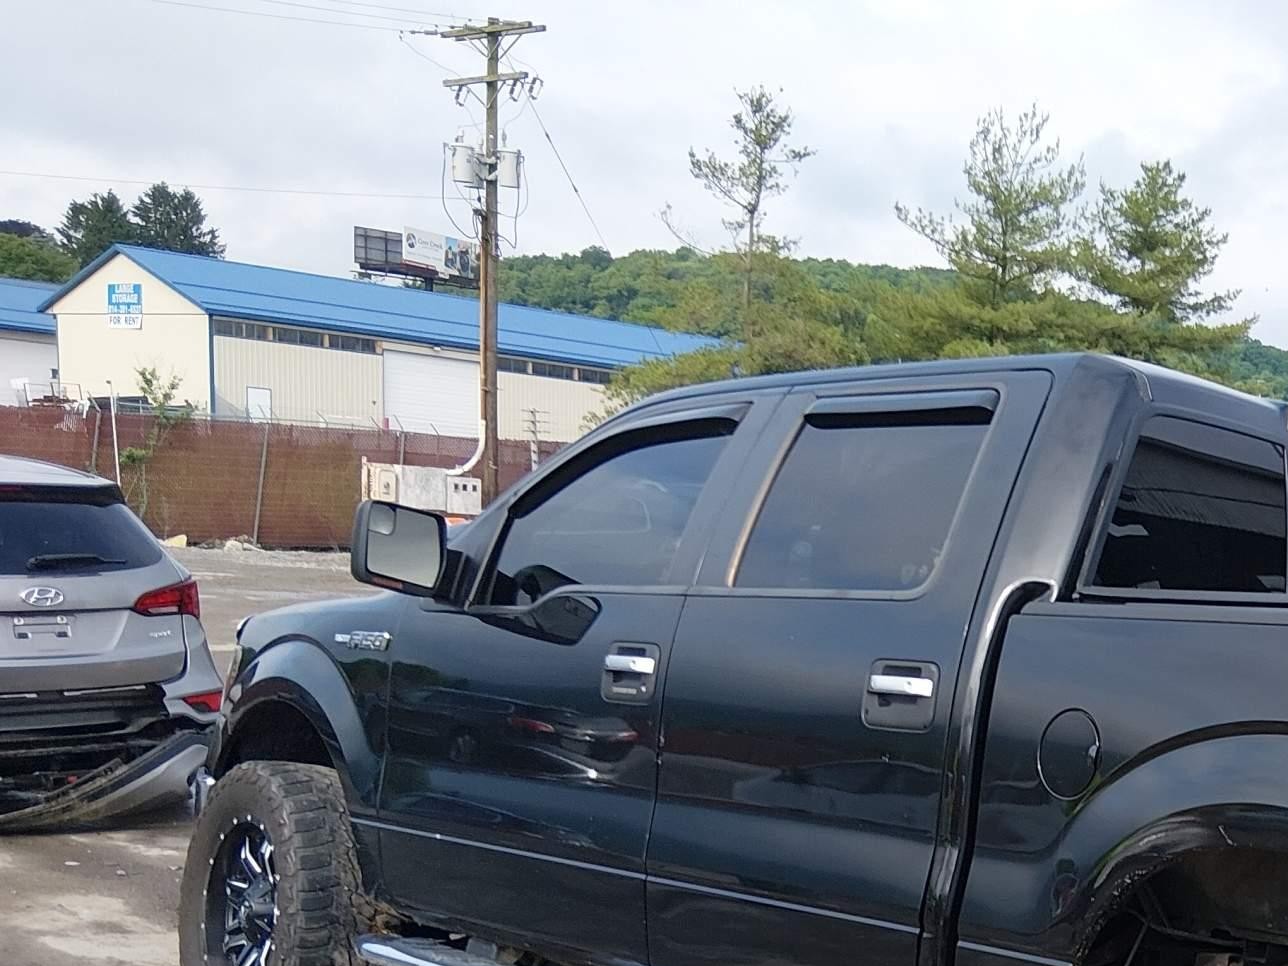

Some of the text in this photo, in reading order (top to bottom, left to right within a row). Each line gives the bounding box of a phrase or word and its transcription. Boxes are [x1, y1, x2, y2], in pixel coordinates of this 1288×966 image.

[111, 293, 139, 303] STORAGE
[109, 315, 140, 325] FOR RENT
